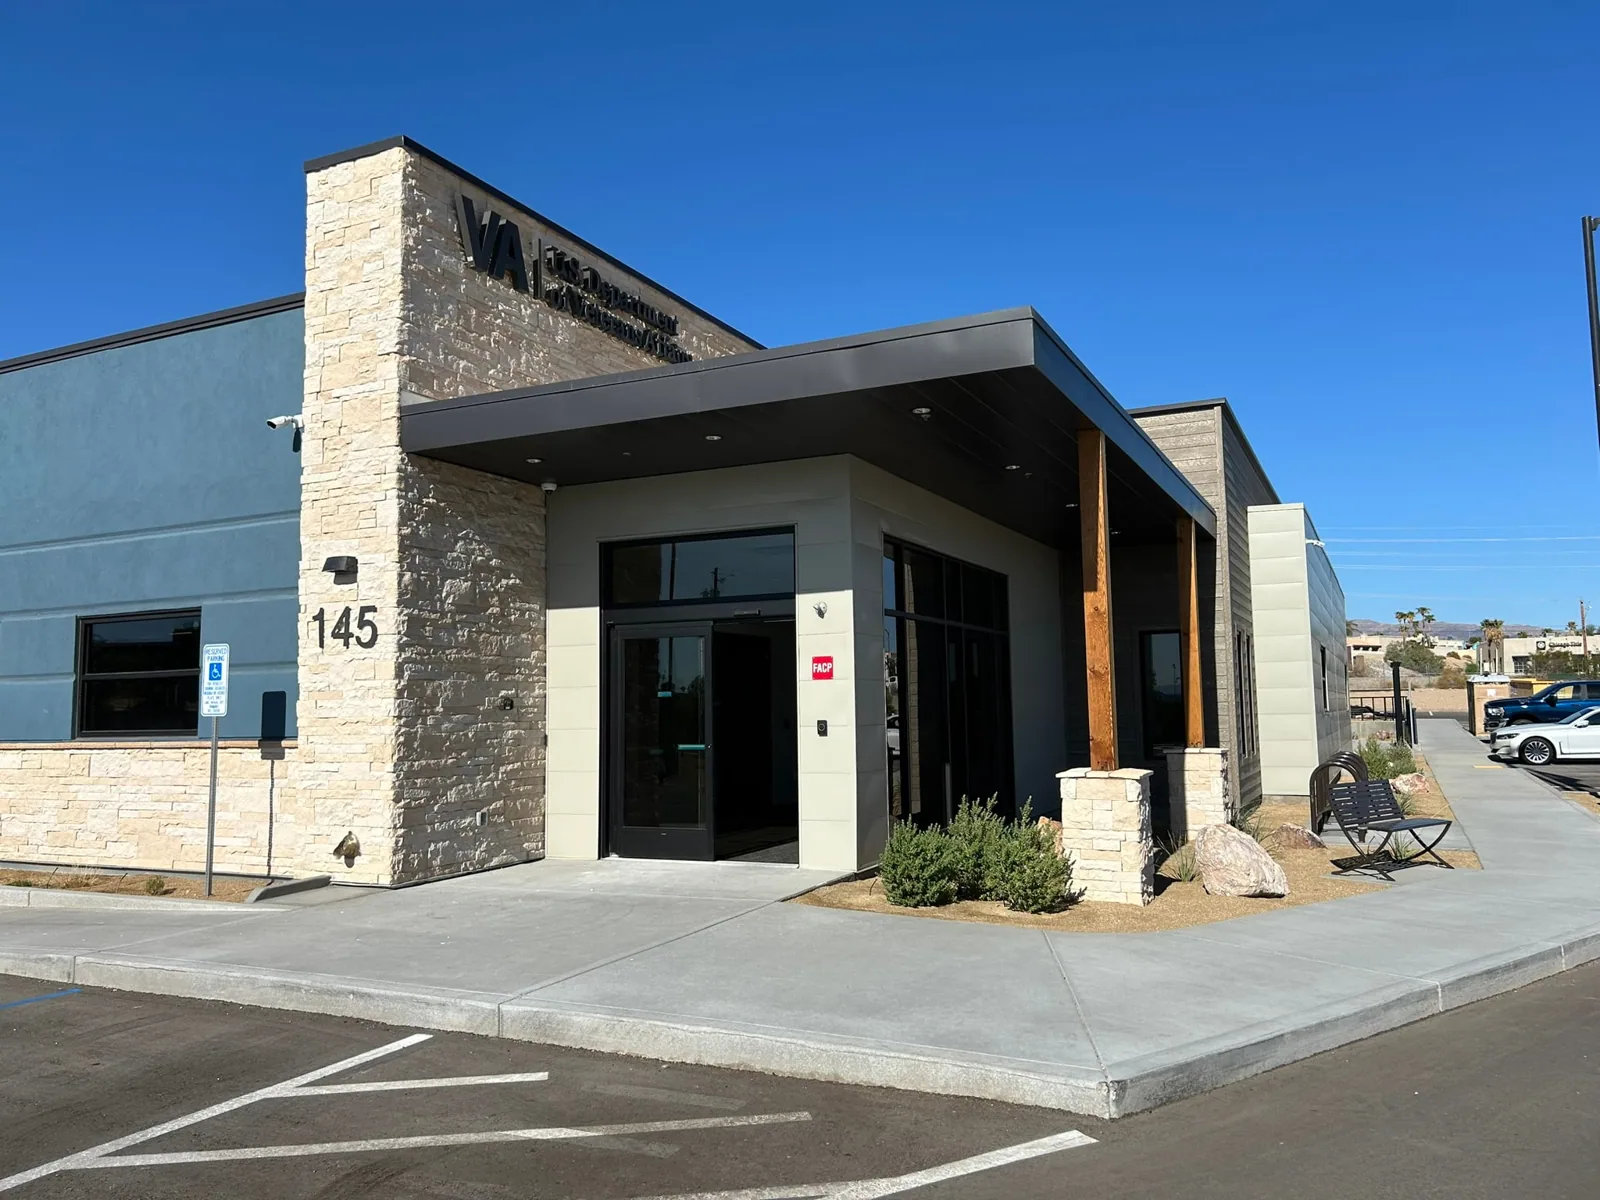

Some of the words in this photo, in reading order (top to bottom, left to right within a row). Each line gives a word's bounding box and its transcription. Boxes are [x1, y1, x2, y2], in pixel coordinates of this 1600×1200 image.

[455, 193, 530, 294] VA
[582, 266, 679, 336] Department
[312, 605, 378, 649] 145
[813, 662, 832, 673] FACP
